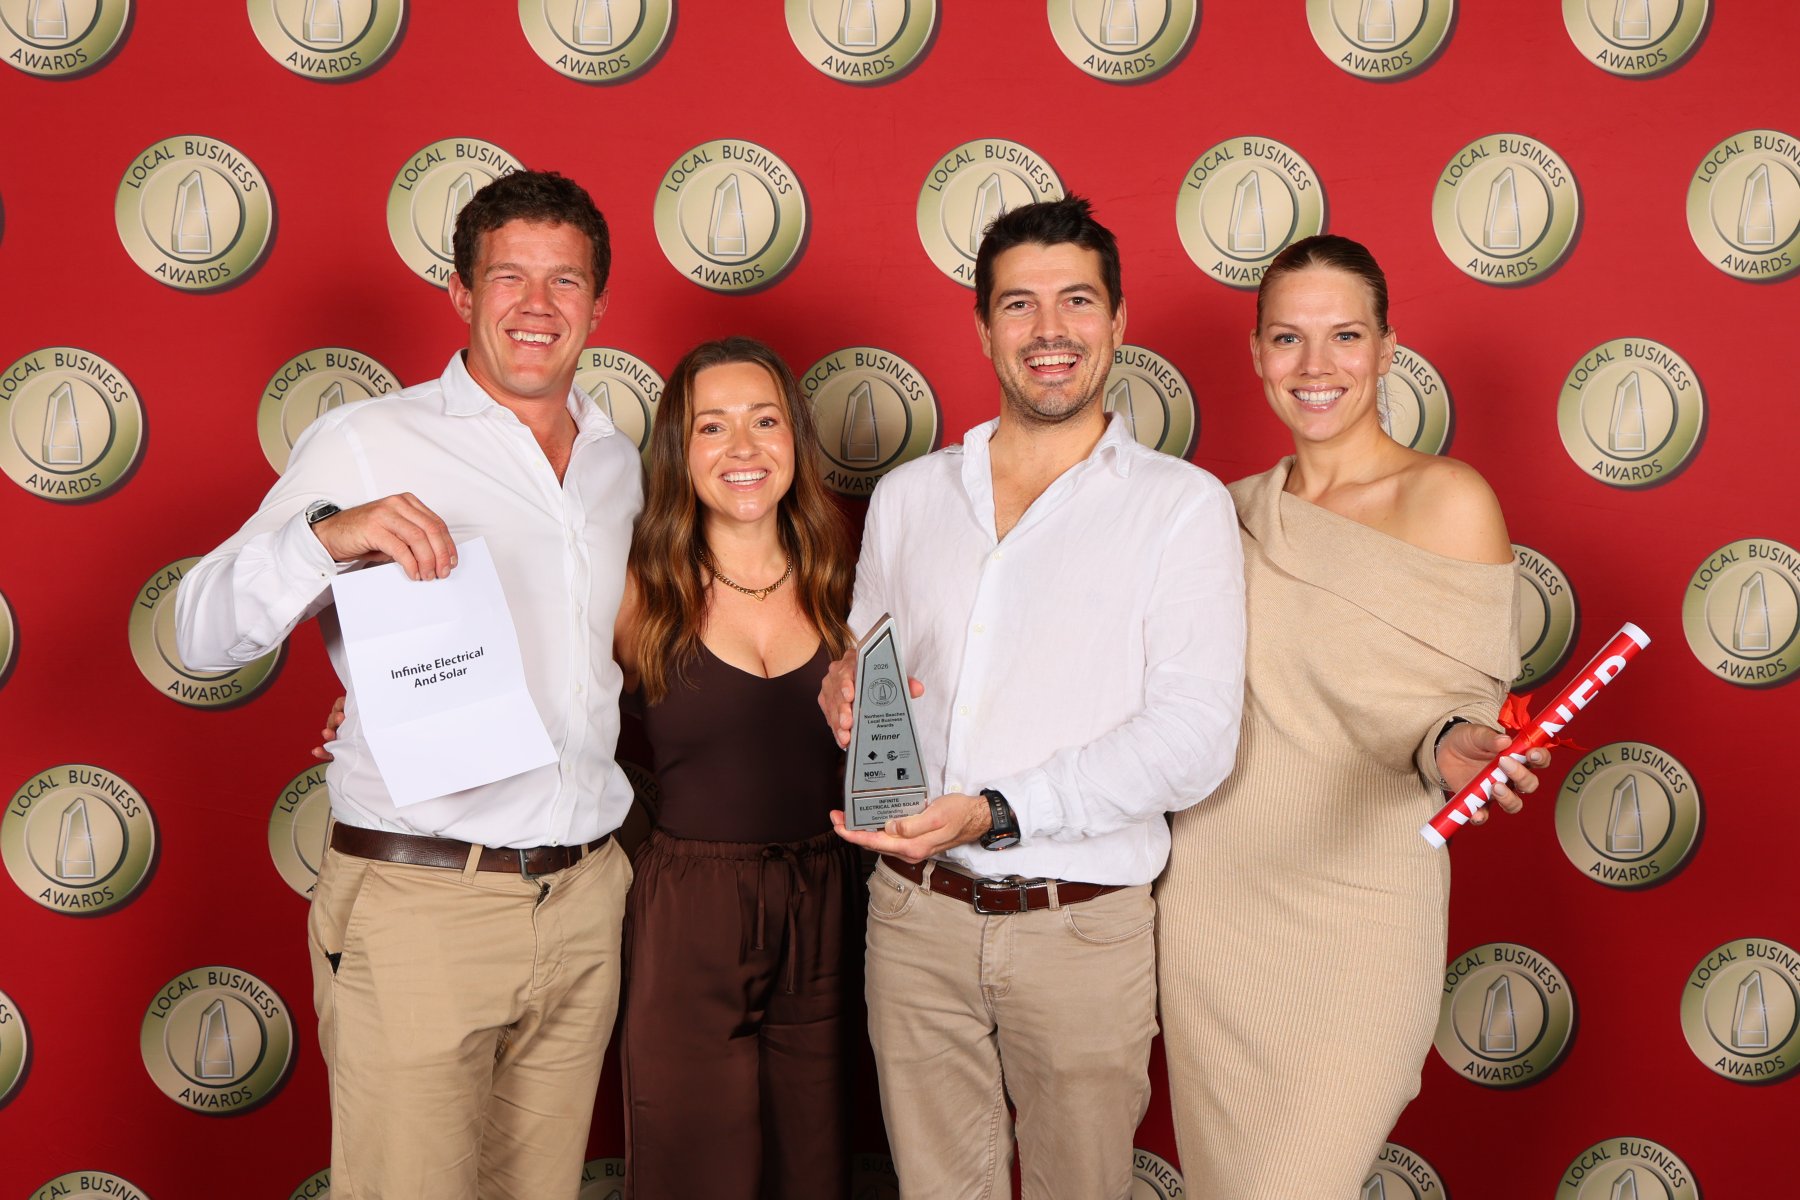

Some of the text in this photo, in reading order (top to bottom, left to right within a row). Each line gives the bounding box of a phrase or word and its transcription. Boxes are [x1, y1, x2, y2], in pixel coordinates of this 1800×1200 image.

[10, 48, 88, 70] AWARDS
[286, 52, 362, 74] AWARDS
[556, 54, 631, 76] AWARDS
[821, 55, 895, 77] AWARDS
[1083, 53, 1156, 75] AWARDS
[1341, 51, 1413, 73] AWARDS
[1596, 49, 1668, 70] AWARDS
[126, 141, 258, 193] LOCAL BUSINESS
[398, 143, 515, 191] LOCAL BUSINE
[666, 145, 793, 195] LOCAL BUSINESS
[928, 144, 1054, 193] LOCAL BUSINESS
[1188, 142, 1312, 191] LOCAL BUSINESS
[1443, 139, 1567, 189] LOCAL BUSINESS
[1698, 135, 1800, 183] LOCAL BUSIN
[155, 262, 232, 284] AWARDS
[690, 263, 766, 285] AWARDS
[1211, 260, 1270, 282] AWAR
[1467, 256, 1539, 278] AWARDS
[1720, 252, 1792, 274] AWARDS
[0, 353, 128, 402] LOCAL BUSINESS
[268, 353, 393, 400] LOCAL BUSINES
[593, 353, 662, 402] BUSINESS
[803, 353, 924, 401] LOCAL BUSINESS
[1115, 350, 1182, 398] BUSINESS
[1392, 351, 1437, 395] SINESS
[1569, 343, 1691, 392] LOCAL BUSINESS
[25, 473, 102, 494] AWARDS
[824, 470, 882, 491] AWAR
[1592, 459, 1663, 481] AWARDS
[1515, 550, 1562, 596] SINESS
[1694, 544, 1800, 590] LOCAL BUSINE
[391, 646, 485, 680] Infinite Electrical
[414, 667, 468, 688] And Solar
[1717, 658, 1787, 680] AWARDS
[168, 679, 242, 701] AWARDS
[871, 733, 901, 741] Winner
[1566, 747, 1688, 795] LOCAL BUSINESS
[11, 769, 141, 819] LOCAL BUSINESS
[279, 771, 326, 813] LOCAL
[1590, 860, 1660, 882] AWARDS
[39, 886, 114, 909] AWARDS
[1444, 948, 1561, 994] LOCAL BUSINESS
[1692, 943, 1800, 989] LOCAL BUSINE
[151, 971, 279, 1019] LOCAL BUSINESS
[1463, 1059, 1534, 1081] AWARDS
[1715, 1055, 1785, 1077] AWARDS
[178, 1086, 253, 1108] AWARDS
[1133, 1153, 1182, 1198] SINESS
[1379, 1148, 1435, 1192] USINESS
[1565, 1142, 1687, 1189] LOCAL BUSINESS
